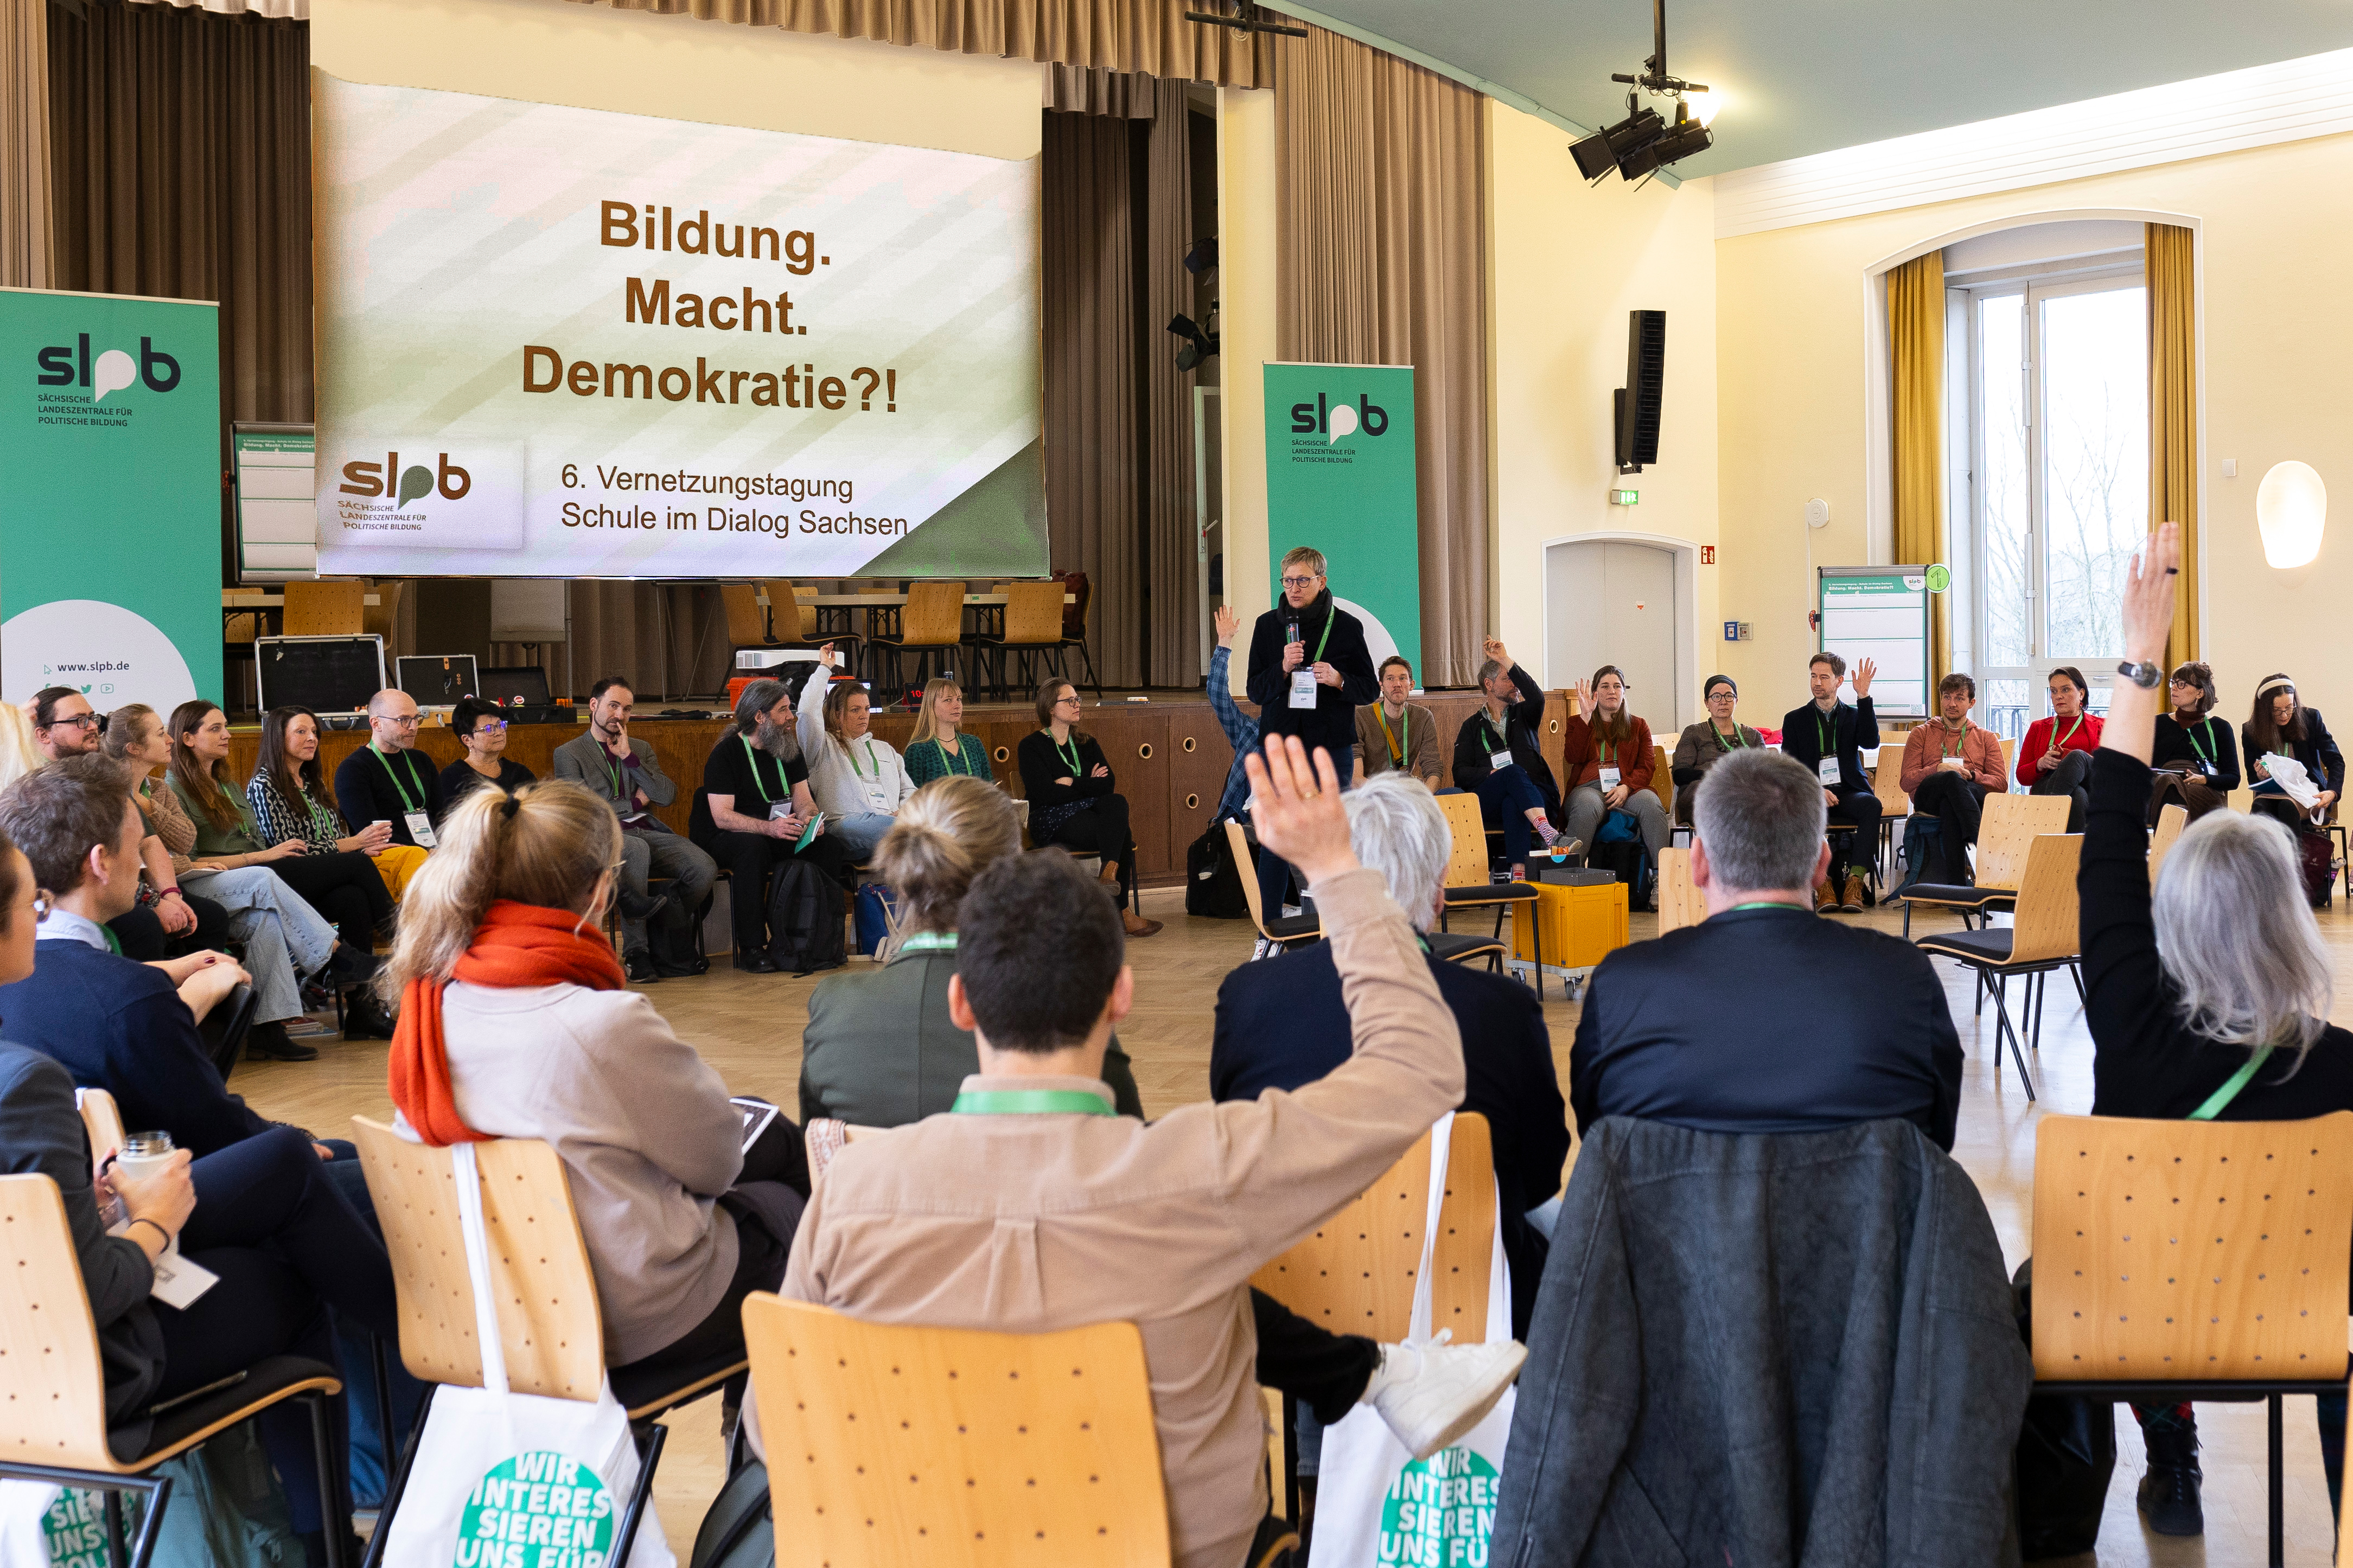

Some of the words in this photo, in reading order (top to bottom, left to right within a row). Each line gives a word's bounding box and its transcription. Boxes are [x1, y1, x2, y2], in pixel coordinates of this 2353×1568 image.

[601, 200, 830, 275] Bildung.
[626, 277, 807, 335] Macht.
[37, 332, 181, 403] slpb
[523, 345, 896, 413] Demokratie?!
[38, 393, 91, 404] SÄCHSISCHE
[38, 406, 114, 415] LANDESZENTRALE
[116, 407, 132, 416] FÜR
[38, 417, 88, 425] POLITISCHE
[90, 418, 127, 427] BILDUNG
[1291, 392, 1389, 446] slpb
[339, 452, 471, 510] slpb
[561, 464, 586, 488] 6.
[596, 465, 853, 504] Vernetzungstagung
[337, 500, 394, 511] SÄCHSISCHE
[339, 510, 411, 521] LANDESZENTRALE
[561, 502, 656, 529] Schule
[667, 507, 697, 530] im
[707, 507, 789, 539] Dialog
[799, 510, 908, 535] Sachsen
[343, 521, 388, 530] POLITISCHE
[57, 661, 130, 673] www.slpb.de
[515, 1452, 580, 1485] WIR
[1429, 1447, 1472, 1479] WIR
[471, 1476, 611, 1519] INTERES
[476, 1507, 597, 1548] SIEREN
[455, 1537, 525, 1568] UNS
[1380, 1531, 1440, 1568] UNS
[1450, 1536, 1489, 1568] FÜ
